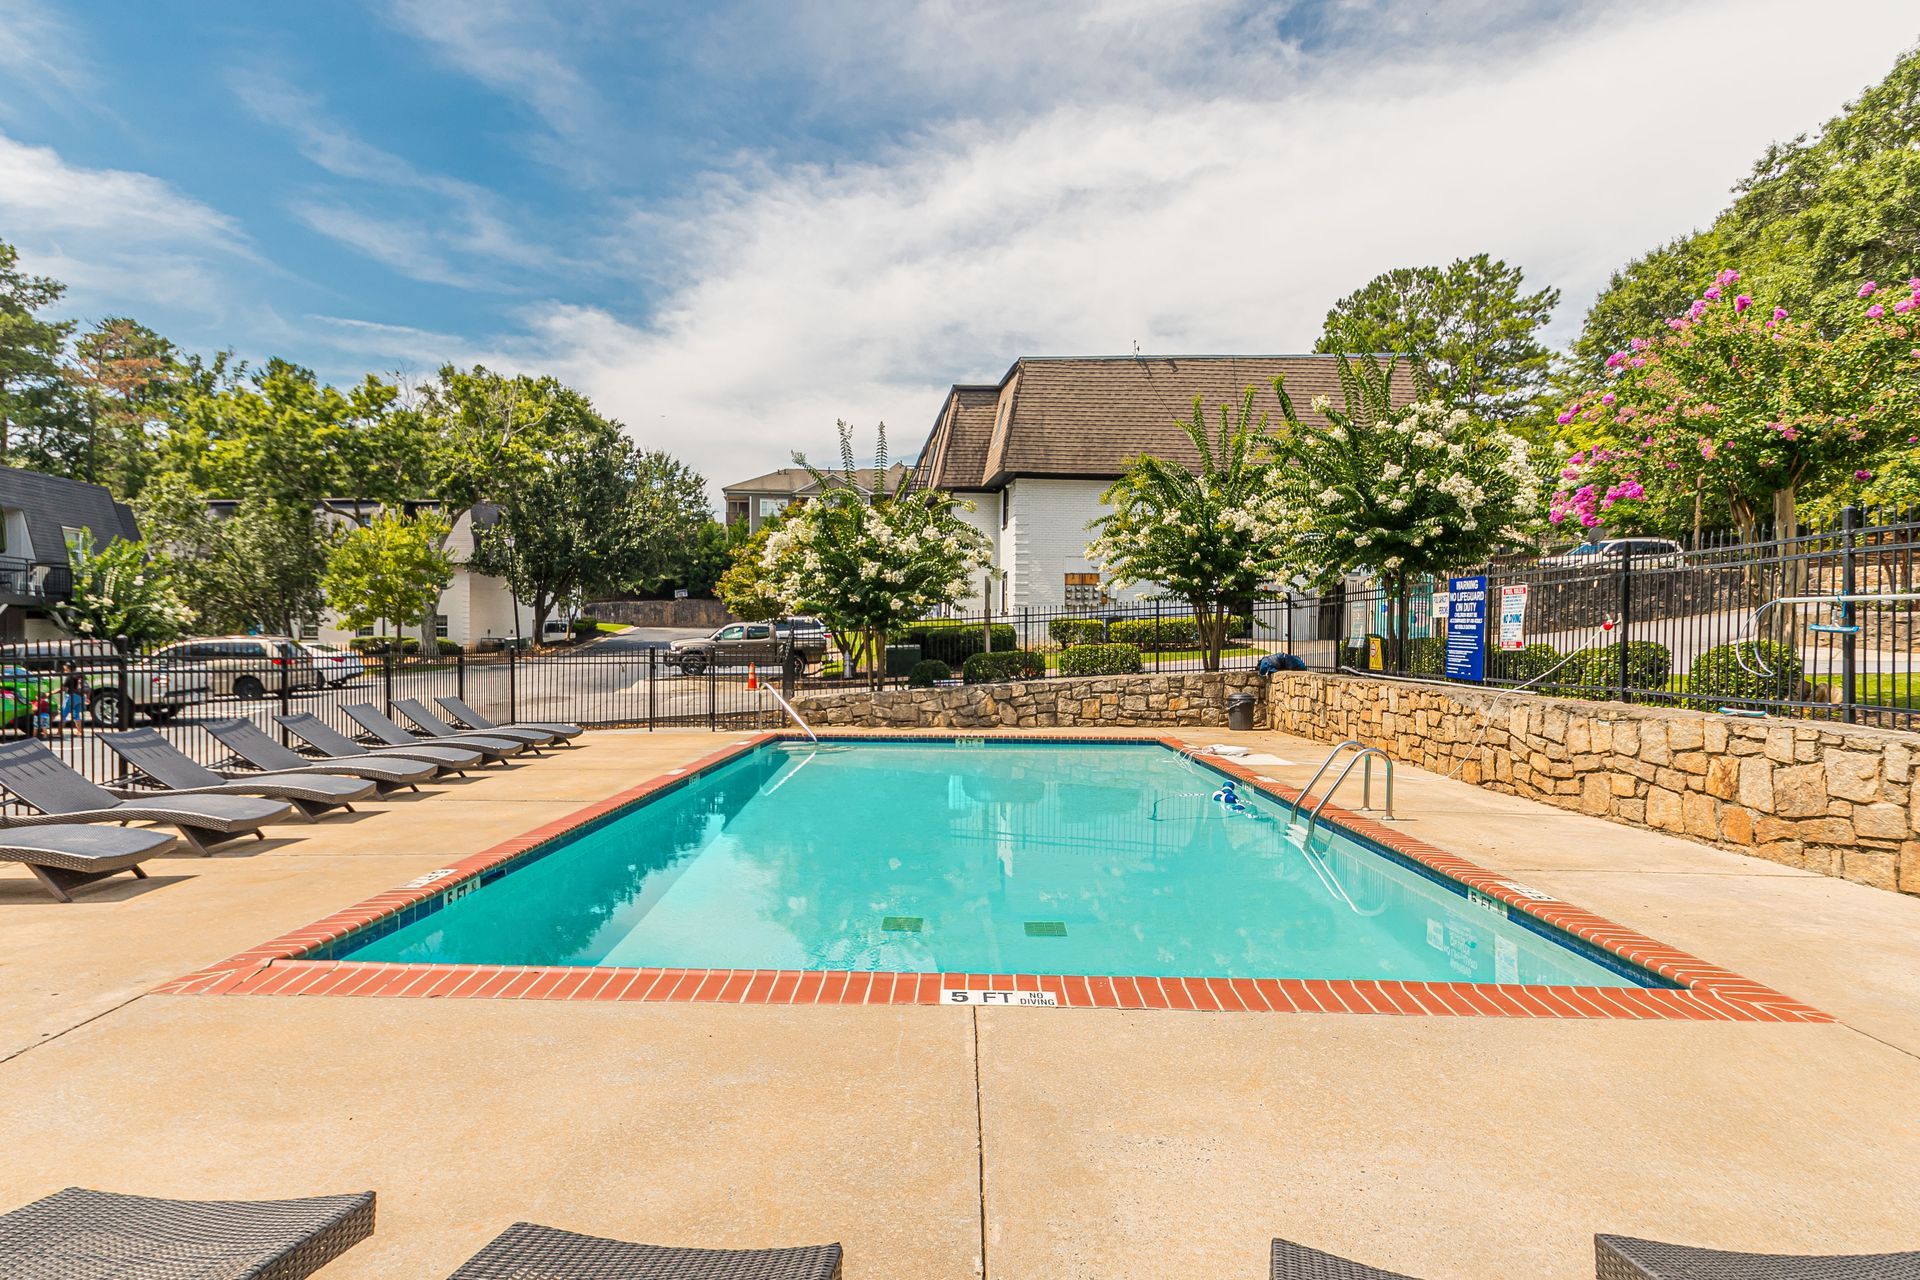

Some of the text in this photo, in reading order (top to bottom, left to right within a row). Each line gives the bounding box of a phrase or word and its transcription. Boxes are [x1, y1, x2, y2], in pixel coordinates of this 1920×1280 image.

[1456, 580, 1478, 590] WARNING
[1450, 593, 1456, 601] NO
[1457, 591, 1484, 601] LIFEGUARD
[1456, 603, 1463, 612] ON
[1464, 602, 1477, 612] DUTY
[457, 884, 468, 901] FT
[1481, 896, 1493, 910] FT
[951, 991, 1013, 1003] 5 FT
[1020, 998, 1055, 1006] DIVING
